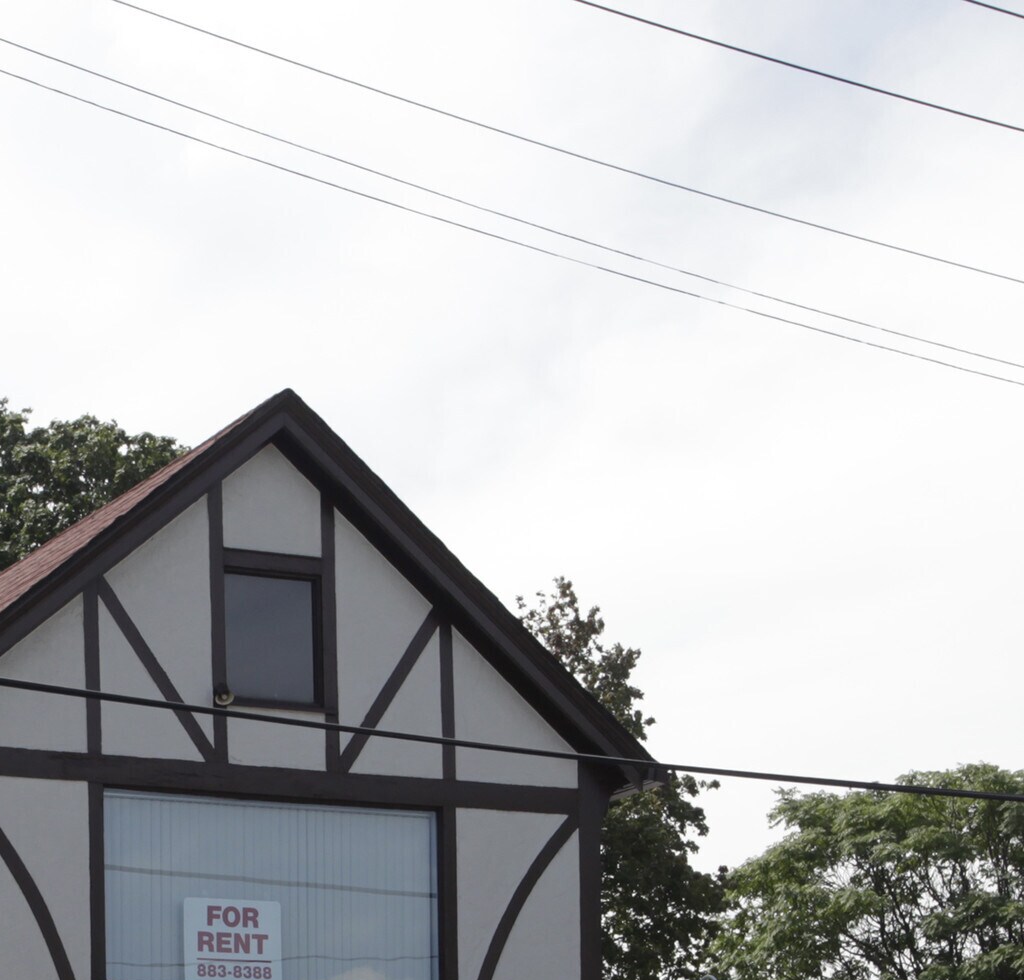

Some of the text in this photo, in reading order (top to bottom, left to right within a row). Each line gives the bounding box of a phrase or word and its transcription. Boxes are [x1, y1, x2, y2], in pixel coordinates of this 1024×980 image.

[207, 905, 259, 928] FOR
[197, 931, 269, 955] RENT
[197, 963, 273, 980] 883-8388
